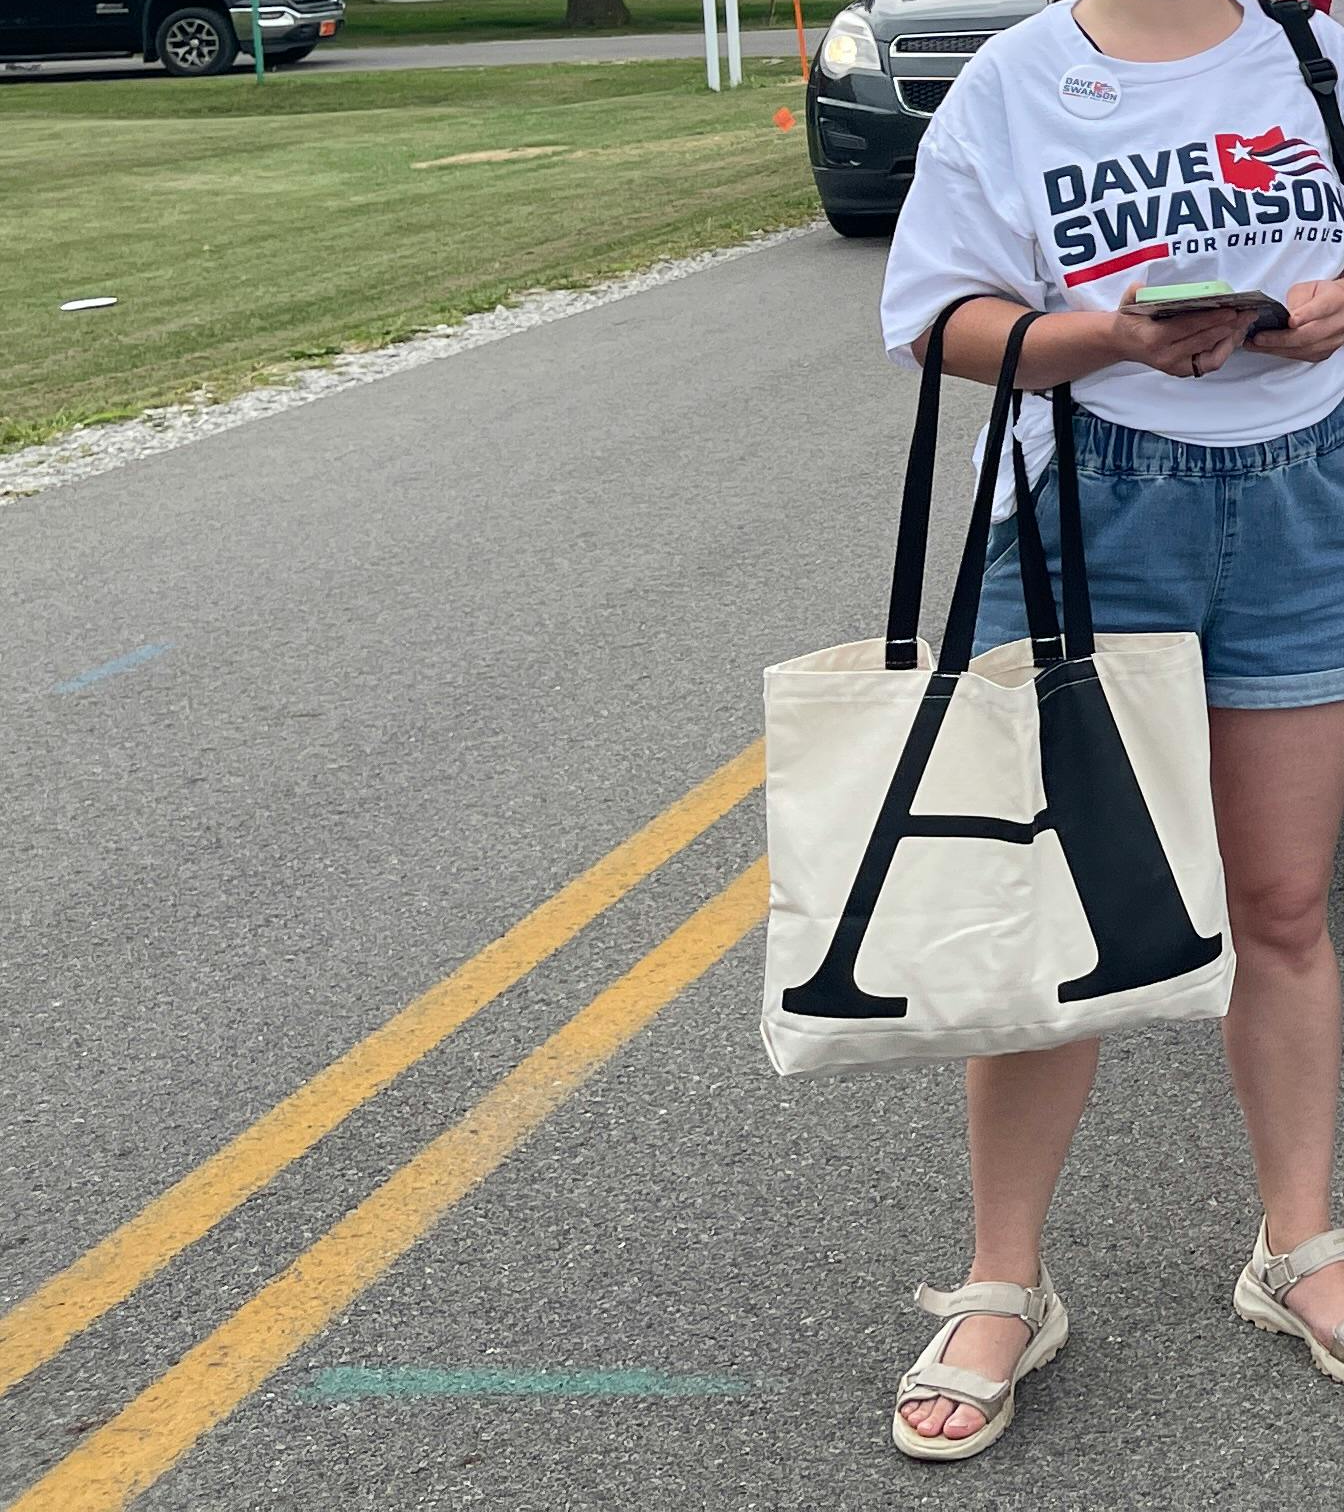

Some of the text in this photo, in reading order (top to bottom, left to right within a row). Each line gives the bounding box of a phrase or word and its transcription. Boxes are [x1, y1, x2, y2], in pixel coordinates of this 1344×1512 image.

[1062, 85, 1118, 101] SWANSON
[1064, 77, 1094, 88] DAVE
[1043, 142, 1215, 216] DAVE
[1172, 237, 1217, 256] FOR
[1227, 229, 1283, 247] OHIO
[782, 660, 1223, 1019] A
